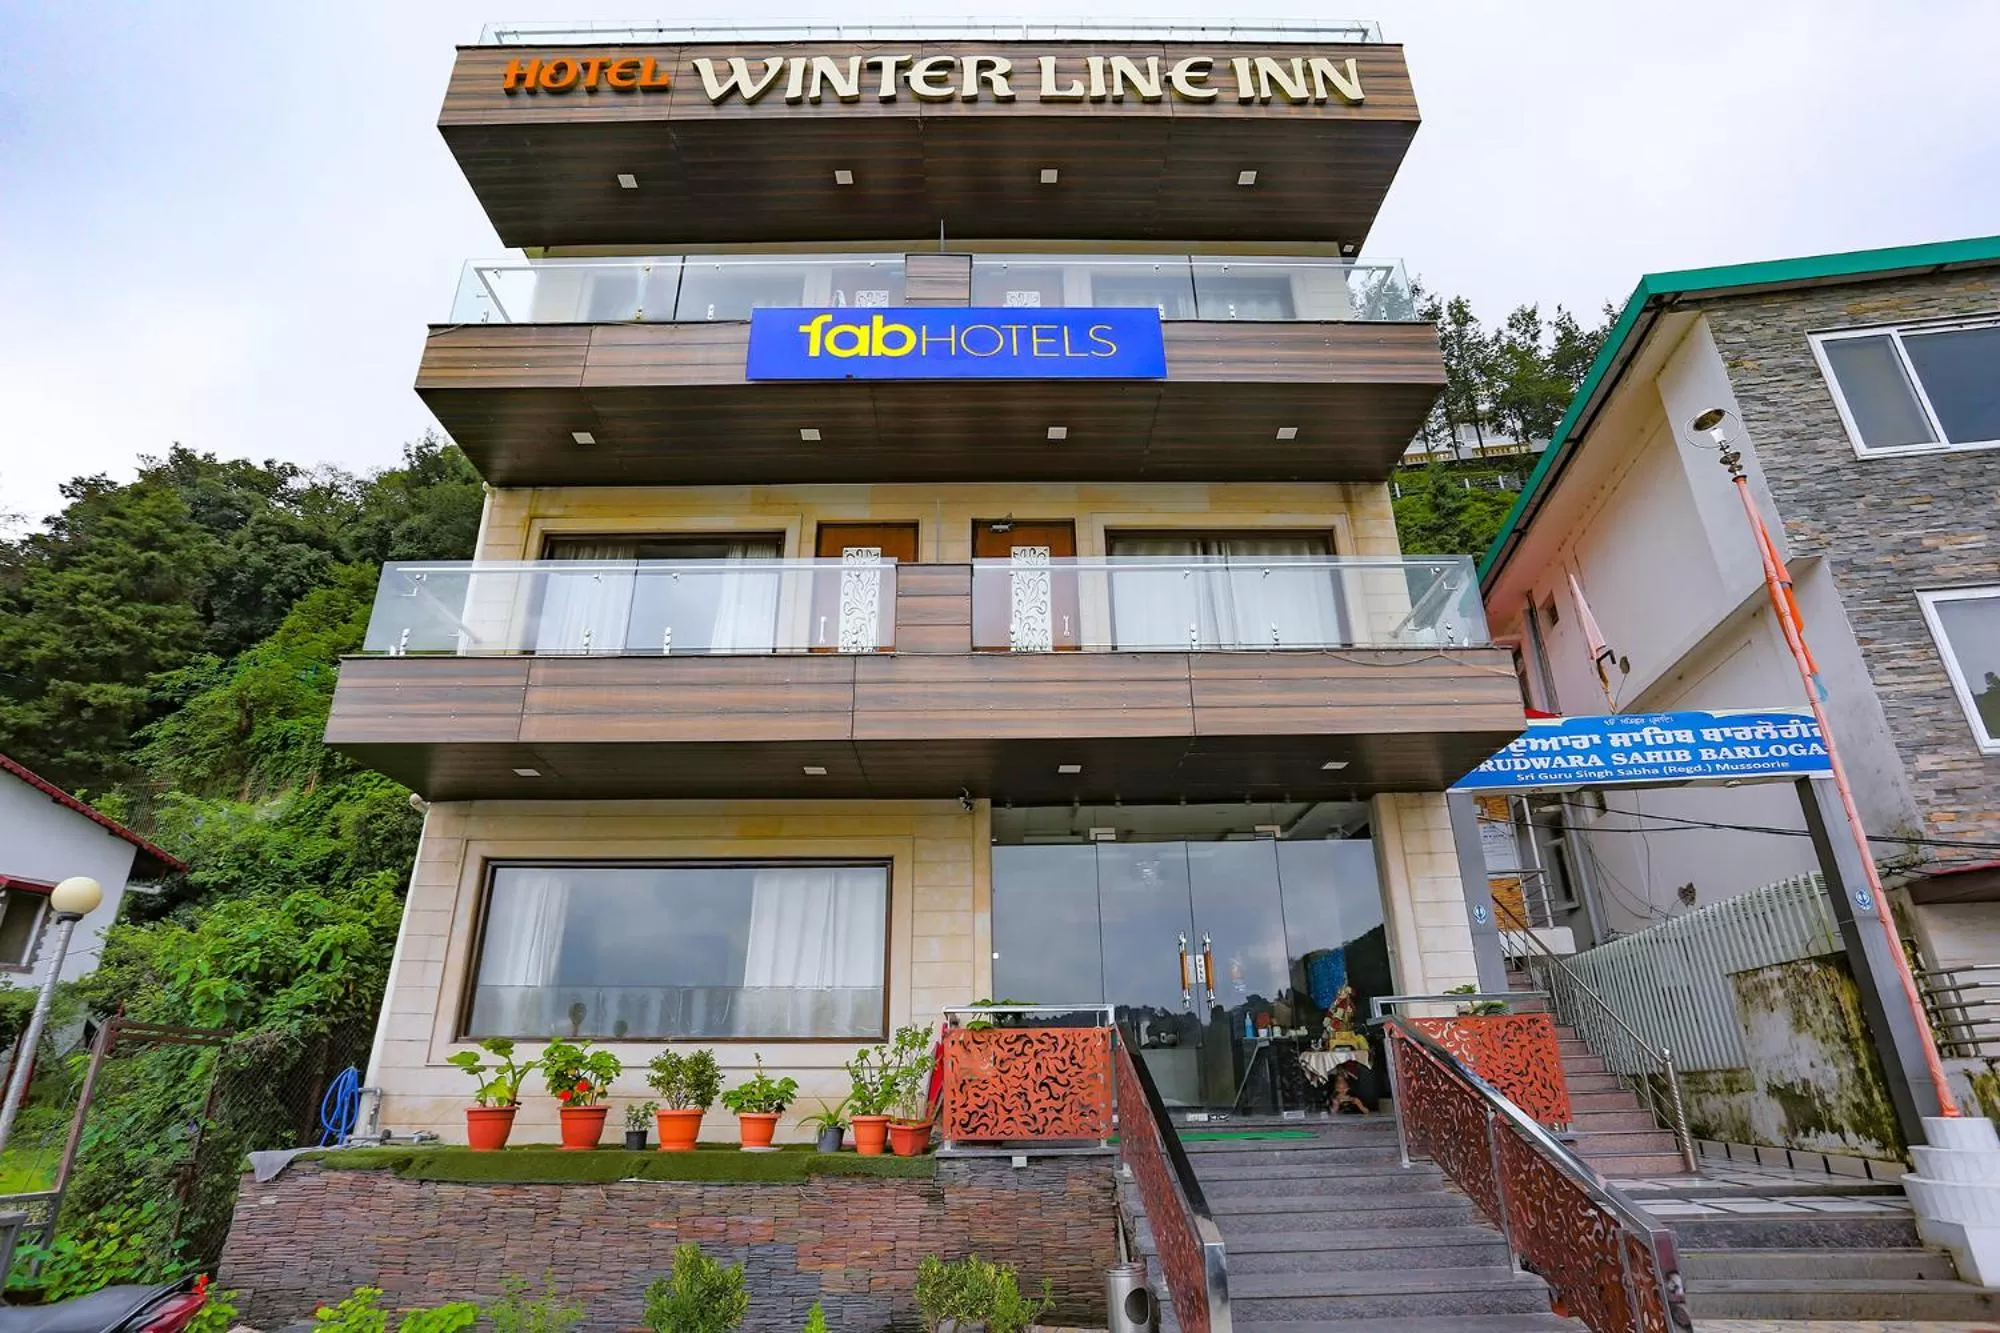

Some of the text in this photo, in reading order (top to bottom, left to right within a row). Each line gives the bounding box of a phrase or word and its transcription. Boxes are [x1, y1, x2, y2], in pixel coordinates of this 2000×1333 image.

[503, 54, 1365, 104] HOTEL WINTER LINE INN
[1607, 726, 1696, 748] ਸਾਹਿਬ
[1474, 743, 1828, 773] RUDWARA SAHIB BARLOGA
[1516, 761, 1789, 782] Sri Guru Singh Sabha (Regd.) Mussoorie
